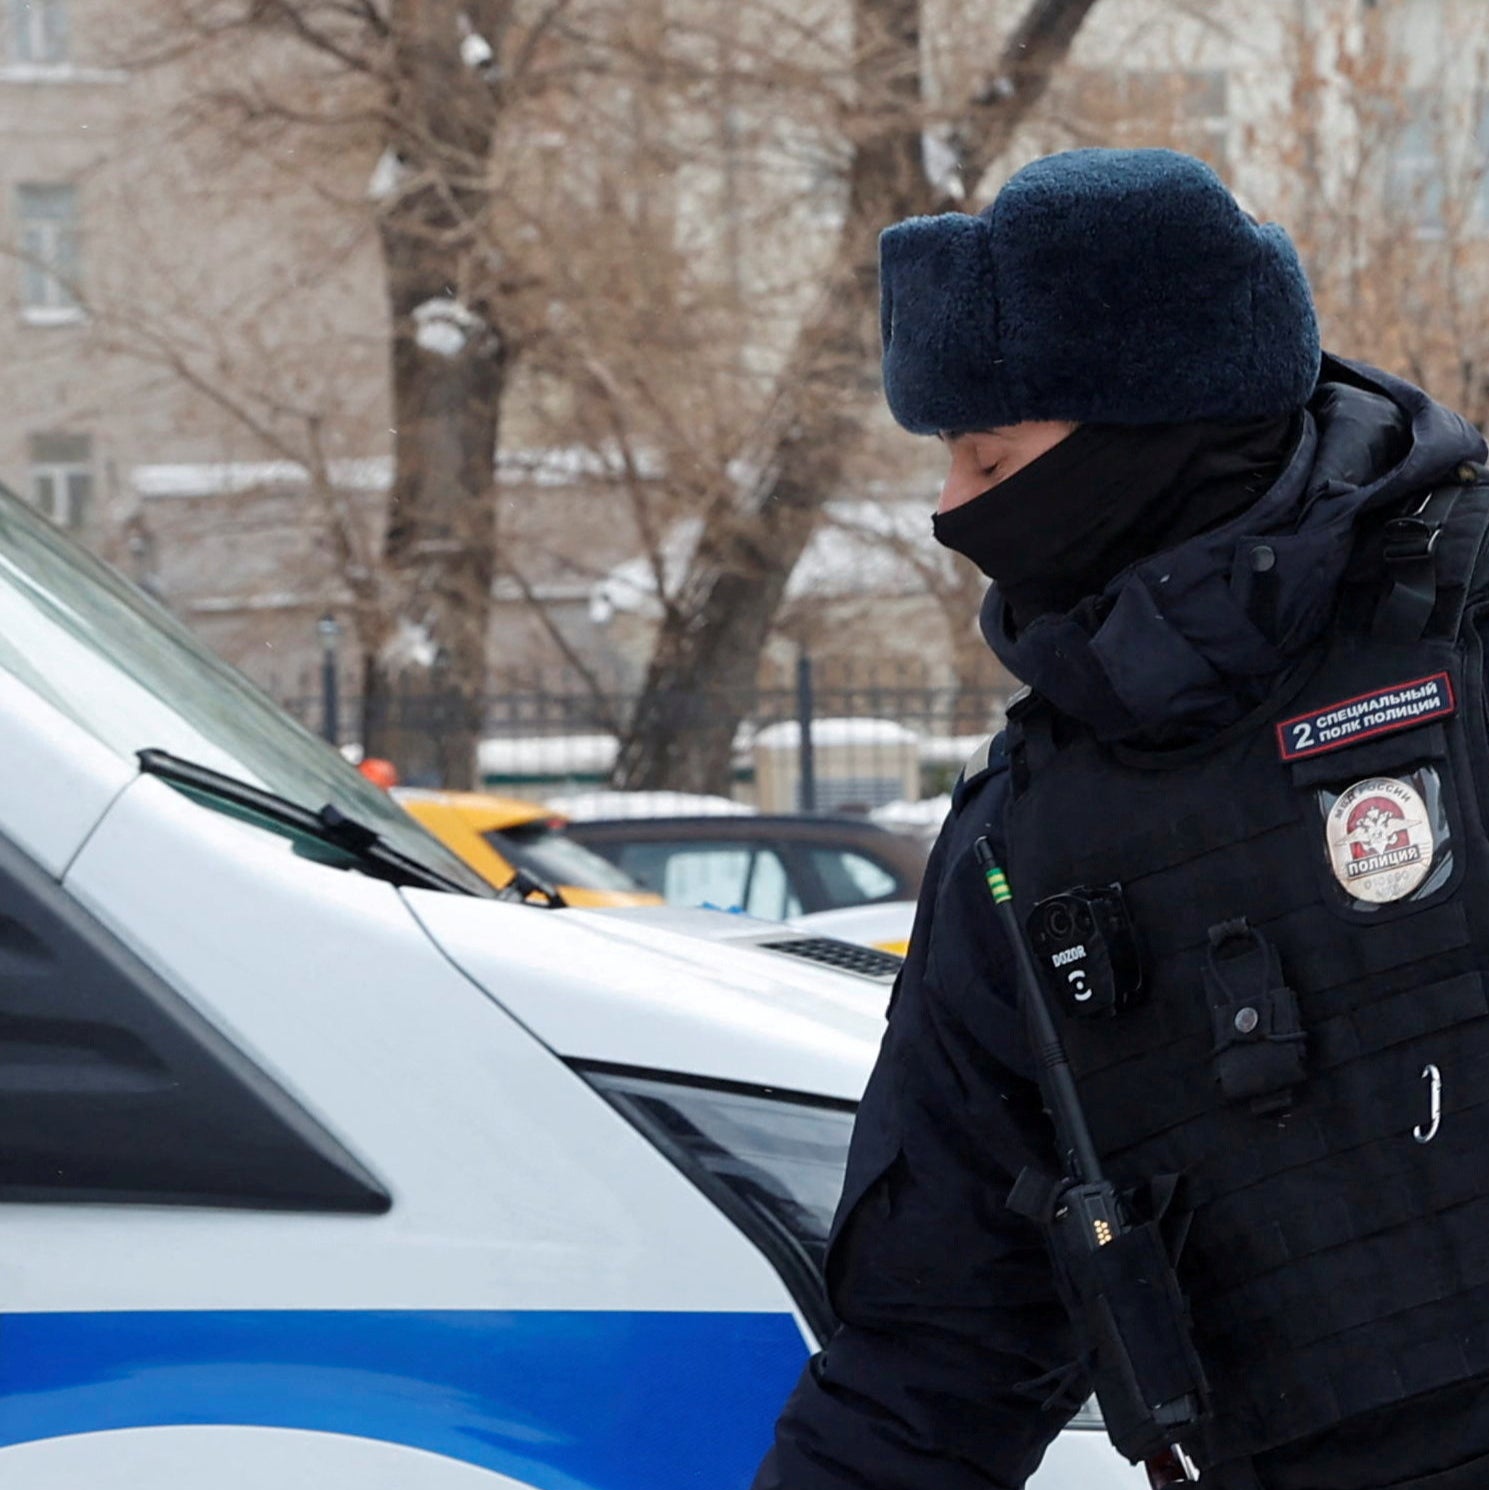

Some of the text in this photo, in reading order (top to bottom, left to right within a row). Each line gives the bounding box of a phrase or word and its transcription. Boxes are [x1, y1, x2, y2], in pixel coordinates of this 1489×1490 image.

[1292, 681, 1438, 750] 2 СПЕЦИАЛЬНЫЙ
[1319, 696, 1440, 742] ПОЛК ПОЛИЦИИ
[1348, 847, 1419, 876] ПОЛИЦИЯ
[1052, 945, 1087, 968] DOZOR
